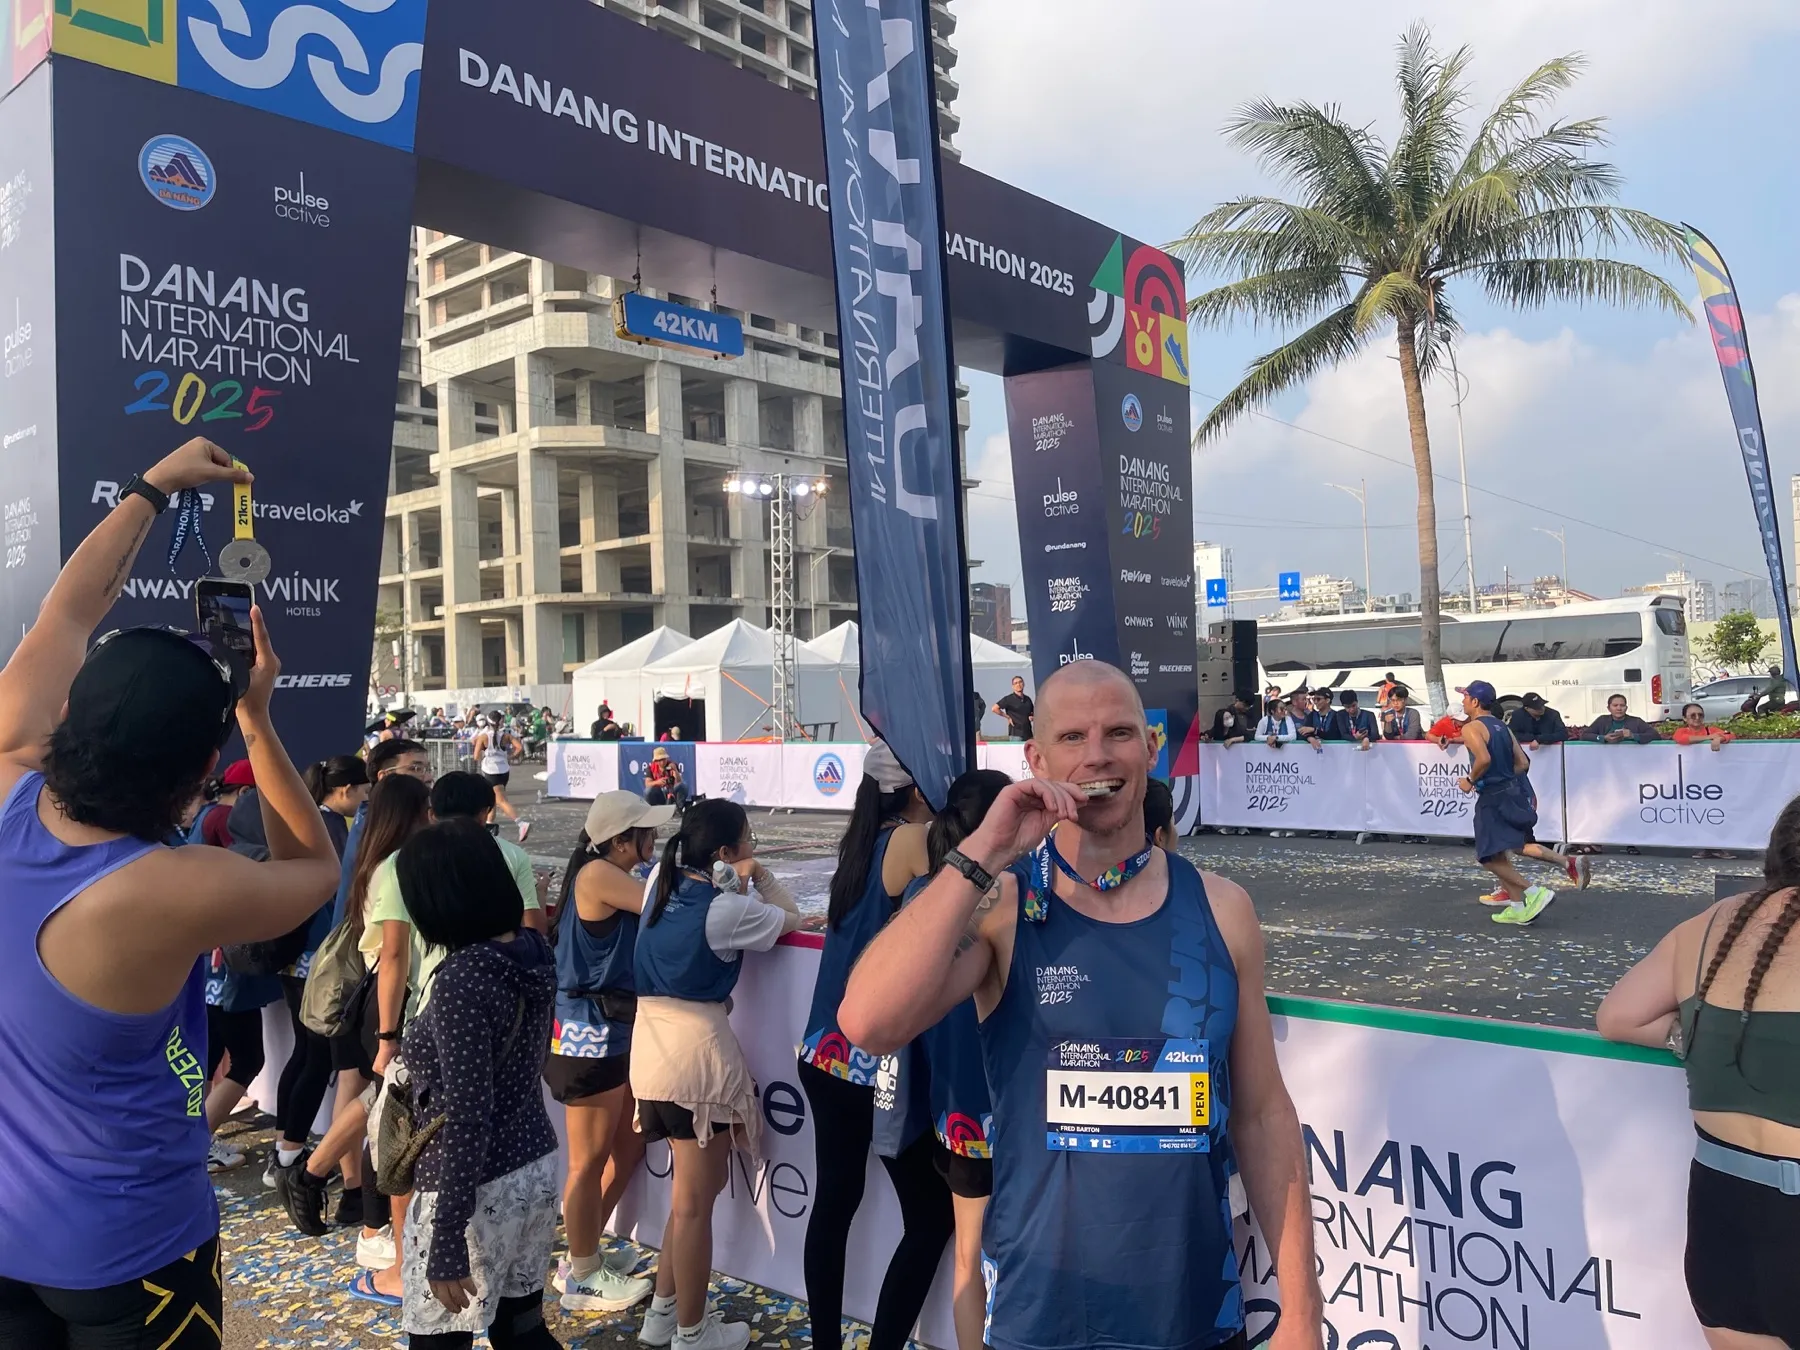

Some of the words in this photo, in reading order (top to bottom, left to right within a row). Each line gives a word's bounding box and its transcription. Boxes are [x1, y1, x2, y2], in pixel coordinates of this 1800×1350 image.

[459, 47, 639, 143] DANANG
[648, 119, 831, 213] INTERNATIO
[274, 171, 330, 211] pulse
[275, 204, 330, 228] active
[945, 230, 1025, 281] ATHON
[1030, 261, 1075, 297] 2025
[120, 253, 309, 323] DANANG
[121, 295, 360, 363] INTERNATIONAL
[653, 311, 719, 344] 42KM
[121, 329, 311, 386] MARATHON
[124, 370, 283, 432] 2025
[1032, 413, 1065, 427] DANANG
[1033, 420, 1075, 434] INTERNATIONAL
[1034, 429, 1067, 440] MARATHON
[1035, 438, 1060, 451] 2025
[1120, 454, 1170, 482] DANANG
[1043, 476, 1078, 507] pulse
[1120, 475, 1184, 502] INTERNATIONAL
[5, 497, 31, 520] DANANG
[239, 494, 248, 526] 21km
[1044, 503, 1079, 517] active
[1120, 492, 1171, 515] MARATHON
[252, 500, 350, 524] traveloka
[1122, 511, 1161, 540] 2025
[168, 508, 191, 565] MARATHON
[1044, 542, 1087, 552] @rundanang
[6, 546, 26, 568] 2025
[1048, 577, 1080, 588] DANANG
[1160, 576, 1188, 588] traveloka
[286, 607, 322, 616] HOTELS
[1051, 600, 1077, 612] 2025
[1124, 615, 1154, 628] ONWAYS
[1159, 664, 1193, 673] SKECHERS
[274, 674, 352, 689] CHERS
[566, 754, 591, 764] DANANG
[720, 757, 748, 767] DANANG
[1245, 761, 1299, 774] DANANG
[1419, 763, 1472, 777] DANAN
[568, 777, 587, 788] 2025
[1245, 775, 1316, 786] INTERNATIONAL
[1639, 754, 1723, 804] pulse
[720, 782, 742, 792] 2025
[1245, 785, 1300, 795] MARATHON
[1247, 795, 1290, 813] 2025
[1420, 800, 1470, 818] 2025
[1640, 802, 1725, 825] active
[1036, 966, 1078, 977] DANANG
[1037, 975, 1092, 984] INTERNATIONAL
[1037, 982, 1080, 992] MARATHON
[1040, 991, 1073, 1005] 2025
[1060, 1043, 1100, 1053] DANANG
[1060, 1052, 1111, 1061] INTERNATIONAL
[1115, 1049, 1149, 1063] 2025
[1164, 1051, 1204, 1063] 42km
[1060, 1059, 1100, 1068] MARATHON
[165, 1025, 204, 1117] ADIZERO
[1196, 1081, 1204, 1089] 3
[1059, 1084, 1180, 1110] M-40841
[1196, 1092, 1204, 1117] PEN
[1300, 1123, 1523, 1229] NANG
[576, 1285, 603, 1298] HOKA
